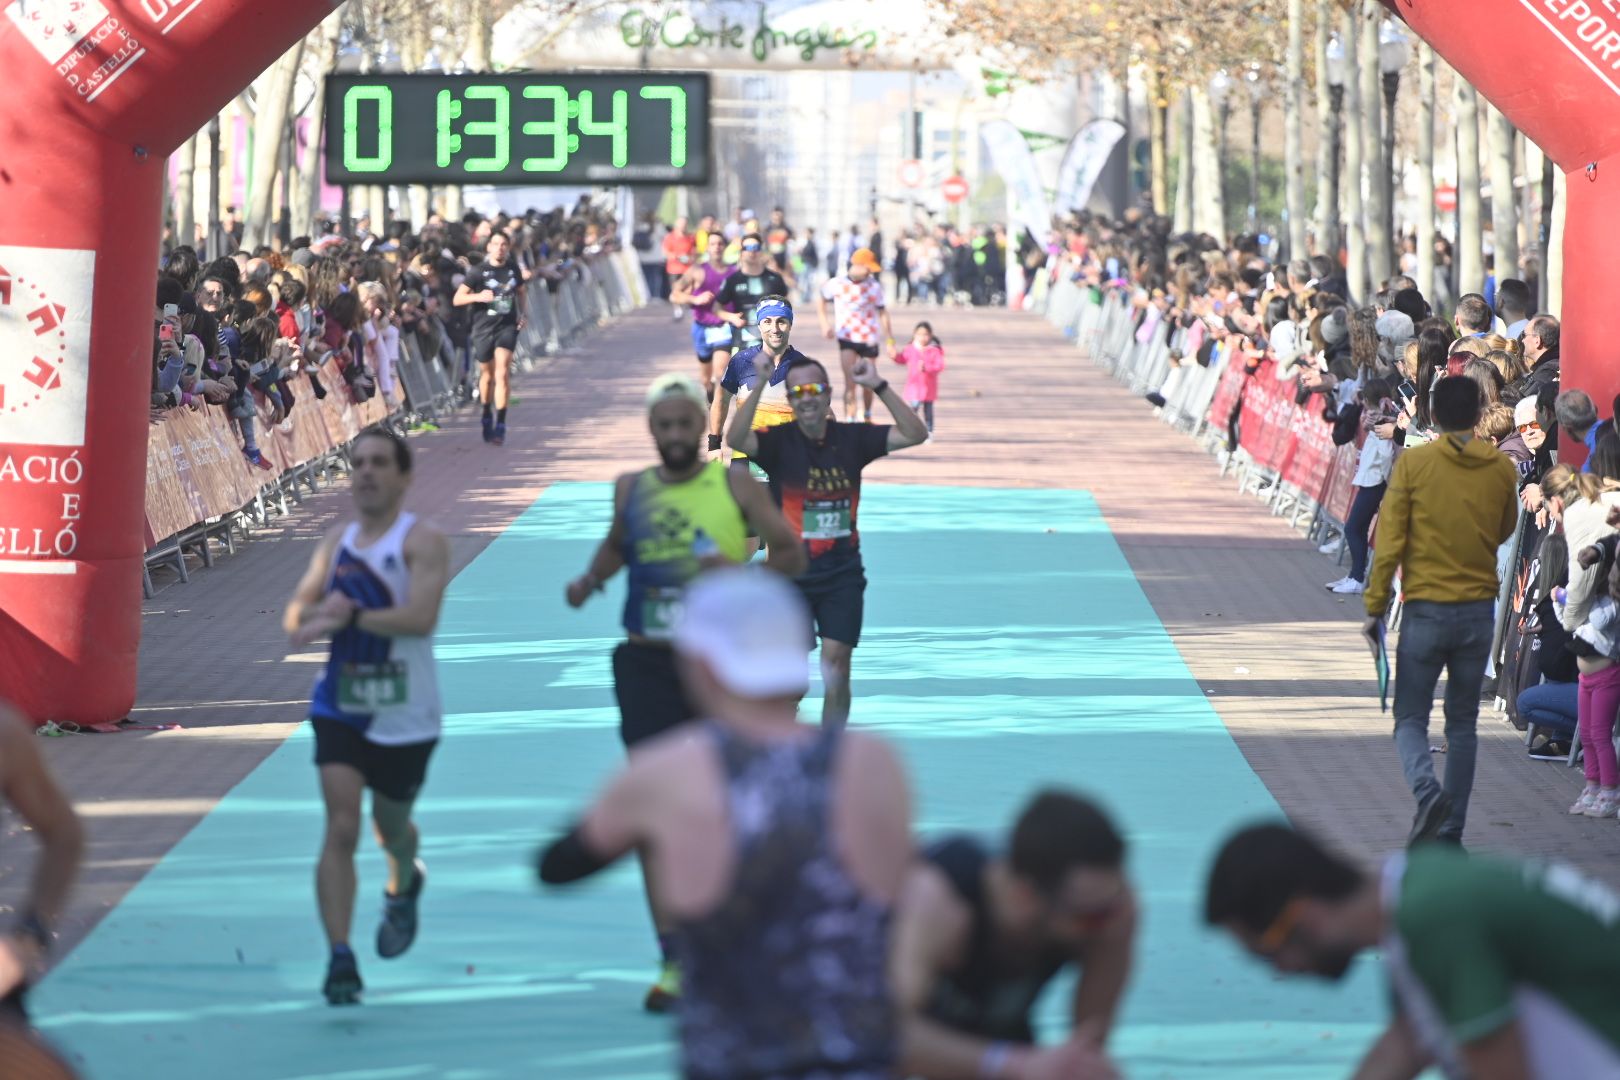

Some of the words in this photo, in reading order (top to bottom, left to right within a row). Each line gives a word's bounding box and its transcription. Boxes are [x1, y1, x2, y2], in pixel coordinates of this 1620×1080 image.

[57, 17, 119, 75] DIPUTACIÓ
[660, 9, 744, 48] Corte
[77, 37, 139, 95] CASTELLÓ
[61, 493, 80, 520] E
